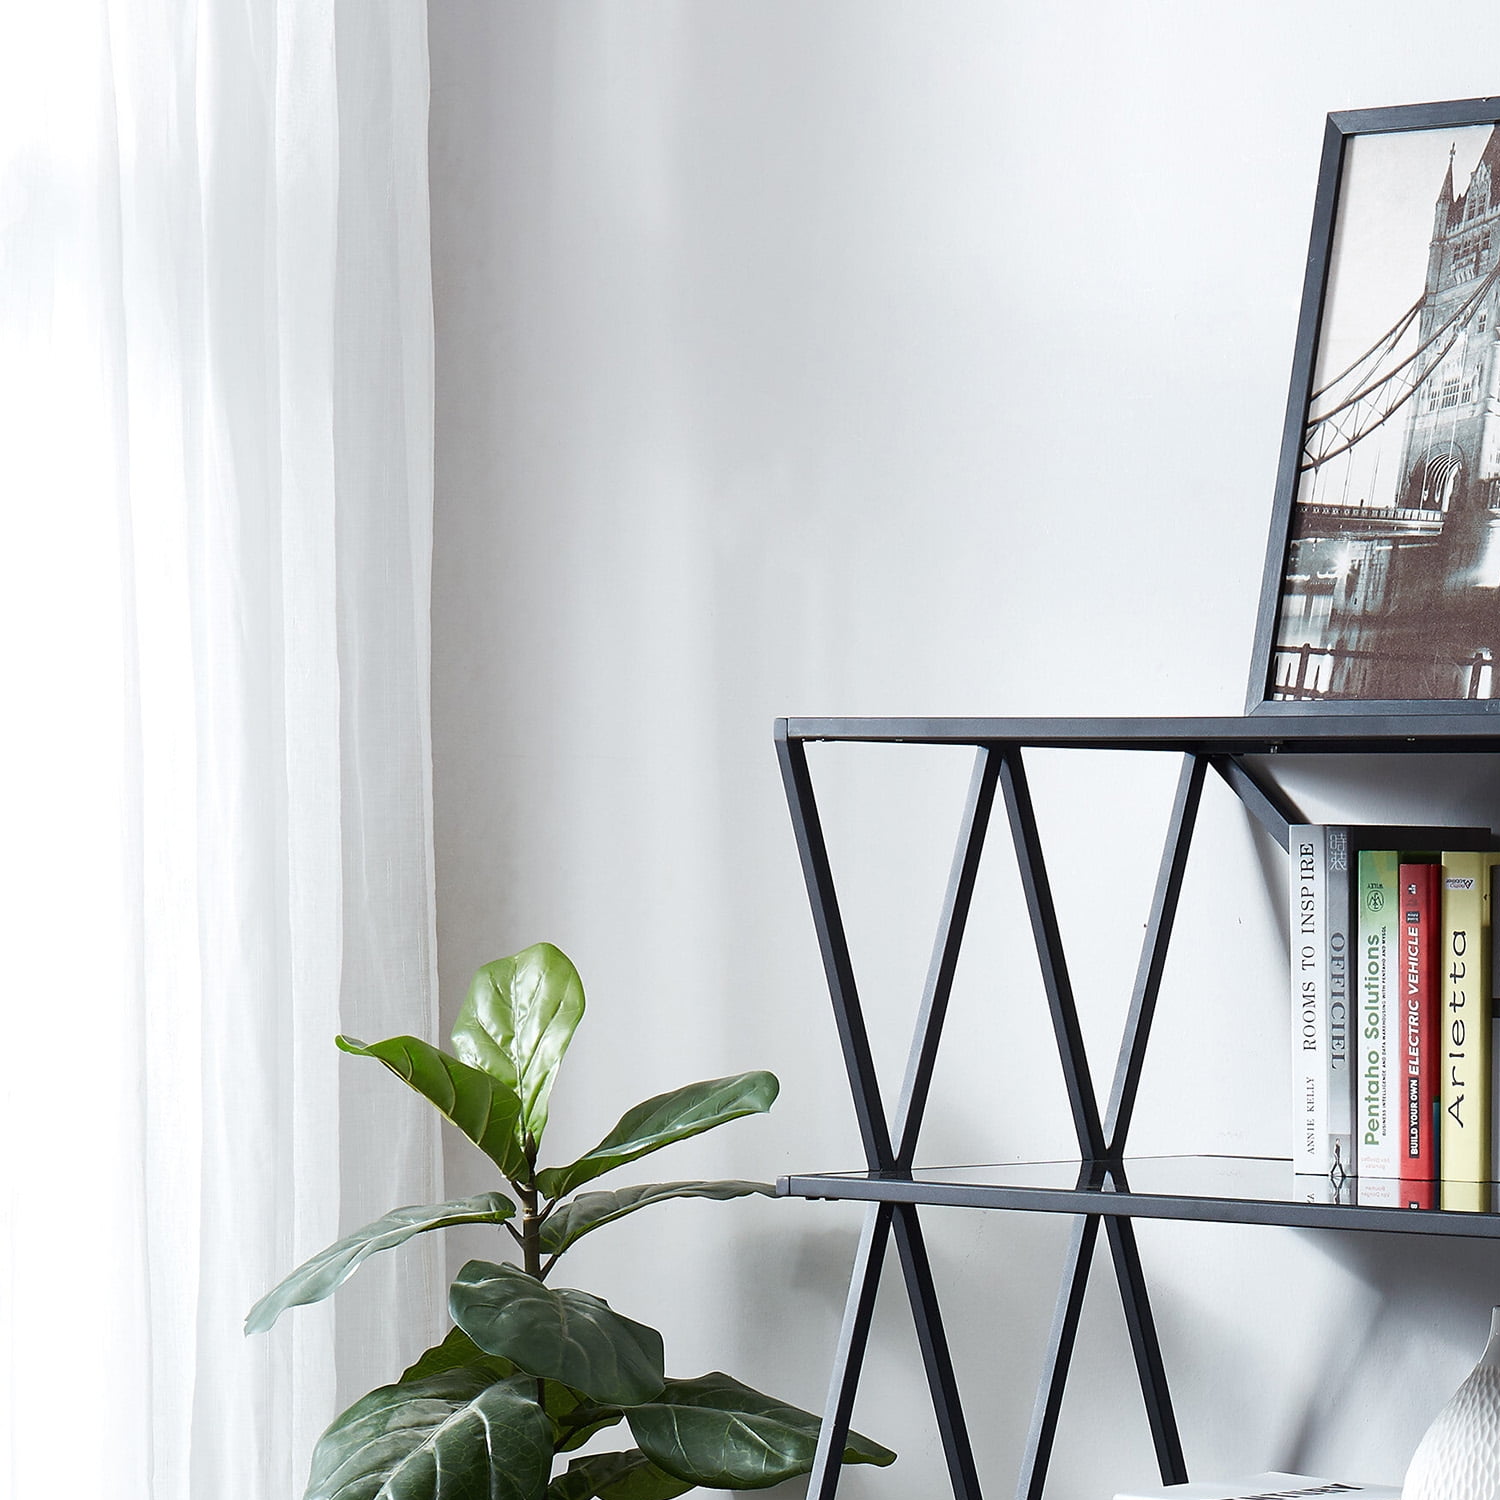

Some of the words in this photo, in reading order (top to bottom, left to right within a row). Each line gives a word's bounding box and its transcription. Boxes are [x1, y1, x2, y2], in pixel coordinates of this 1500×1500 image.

[1301, 946, 1315, 971] TO
[1364, 934, 1379, 1040] Solutions
[1407, 927, 1419, 994] VEHICLE
[1302, 981, 1317, 1051] ROOMS
[1331, 932, 1346, 1070] OFFICIEL
[1448, 931, 1466, 1127] Arletta
[1408, 1001, 1420, 1075] ELECTRIC
[1306, 1076, 1315, 1112] KELLY
[1364, 1050, 1379, 1146] Pentaho
[1409, 1079, 1418, 1101] OWN
[1410, 1102, 1418, 1127] YOUR
[1306, 1119, 1315, 1155] ANNIE
[1410, 1128, 1419, 1155] BUILD
